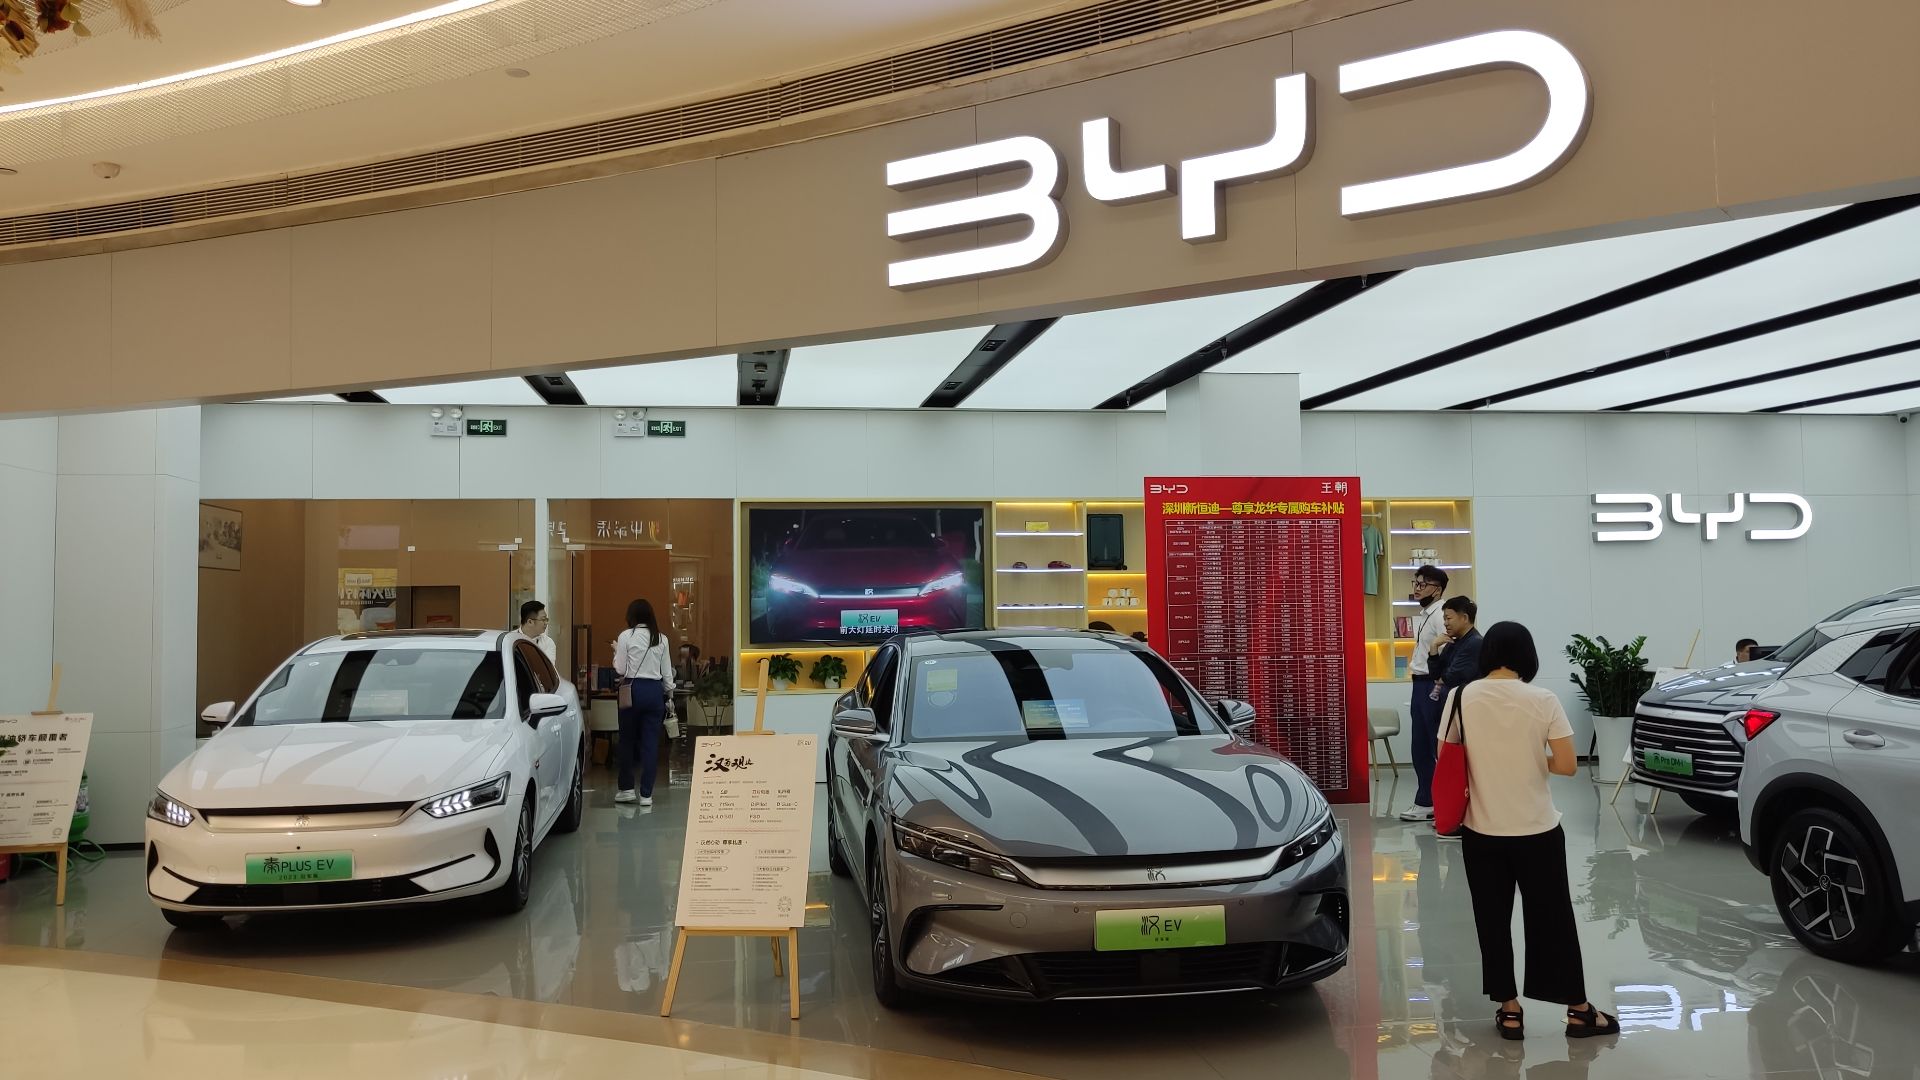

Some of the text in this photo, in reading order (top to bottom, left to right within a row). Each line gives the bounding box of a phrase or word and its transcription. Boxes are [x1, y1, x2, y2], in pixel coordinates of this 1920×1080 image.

[886, 29, 1591, 291] BYD
[1150, 485, 1188, 494] BYD
[1320, 481, 1348, 496] 王朝
[1591, 492, 1813, 543] BYD
[870, 615, 881, 623] EV
[840, 624, 899, 635] 前大灯延时关闭
[316, 859, 335, 871] EV
[1164, 919, 1182, 932] EV
